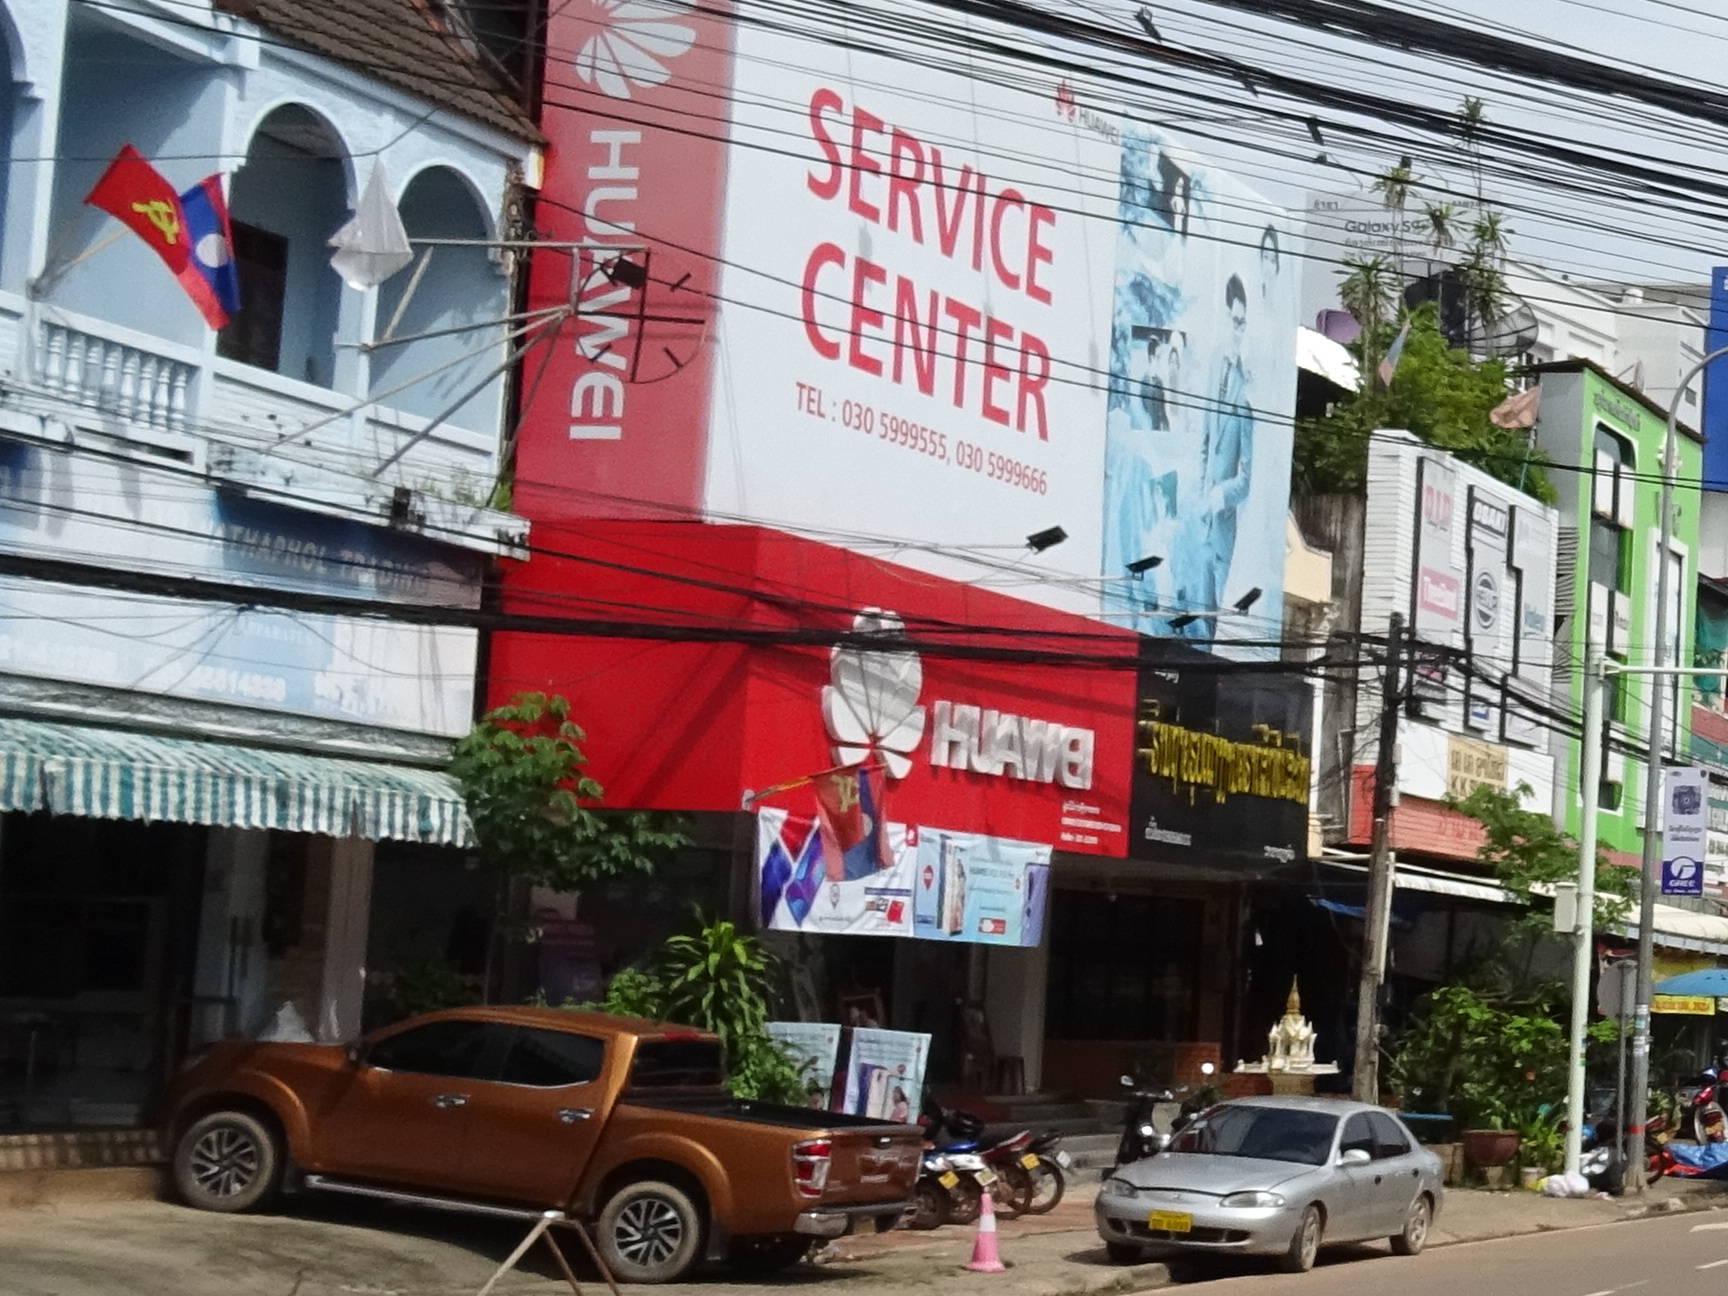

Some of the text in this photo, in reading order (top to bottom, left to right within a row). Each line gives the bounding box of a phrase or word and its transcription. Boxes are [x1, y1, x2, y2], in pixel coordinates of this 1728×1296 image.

[1079, 107, 1120, 145] HUAWEI
[806, 88, 1056, 306] SERVICE
[1345, 220, 1400, 234] Galaxy
[569, 129, 642, 441] HUAWEI
[800, 242, 1050, 443] CENTER
[796, 382, 827, 416] TEL
[841, 398, 874, 435] 030
[879, 410, 951, 467] 5999555,
[956, 439, 984, 475] 030
[988, 449, 1048, 497] 5999666
[930, 699, 1095, 791] HUAWEI
